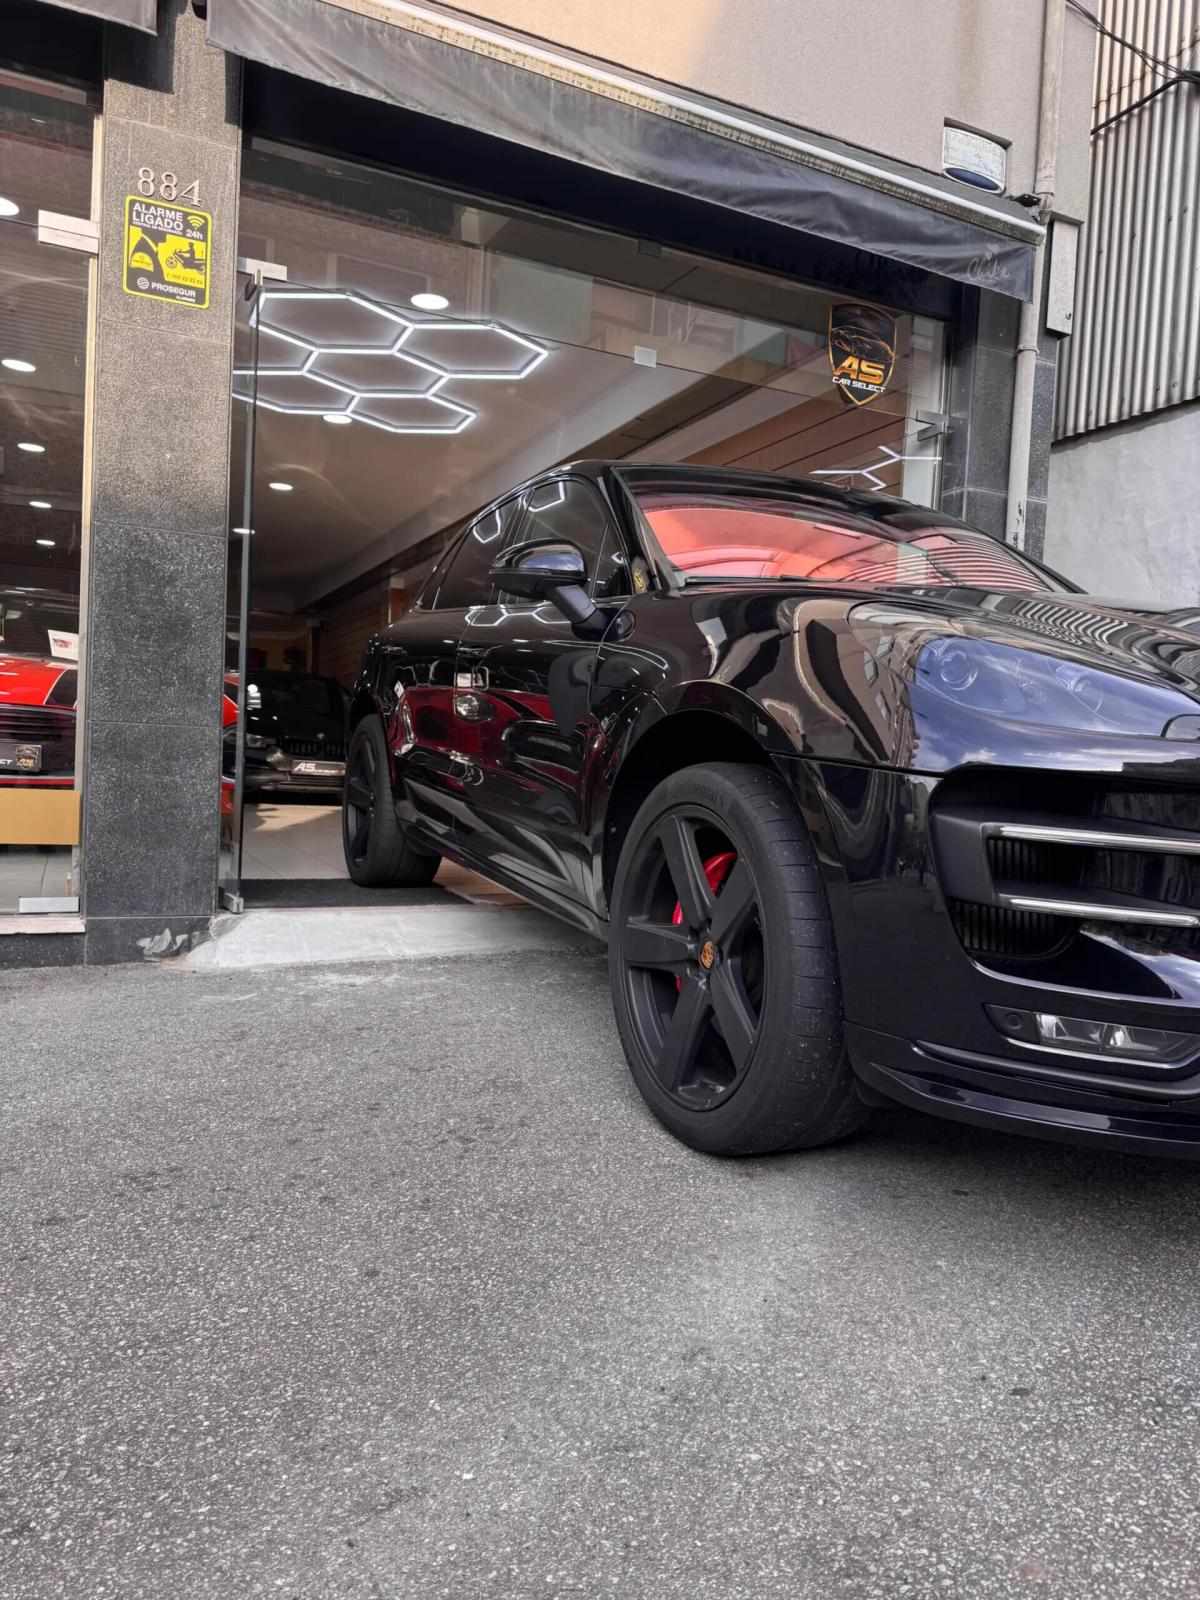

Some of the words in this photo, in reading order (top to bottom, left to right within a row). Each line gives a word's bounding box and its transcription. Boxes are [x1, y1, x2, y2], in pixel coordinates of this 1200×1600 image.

[138, 167, 201, 206] 884
[132, 211, 184, 231] LIGADO
[133, 202, 183, 222] ALARME
[151, 282, 196, 297] PROSEGUR
[833, 355, 885, 384] AS
[832, 376, 851, 386] CAR
[852, 381, 886, 393] SELECT
